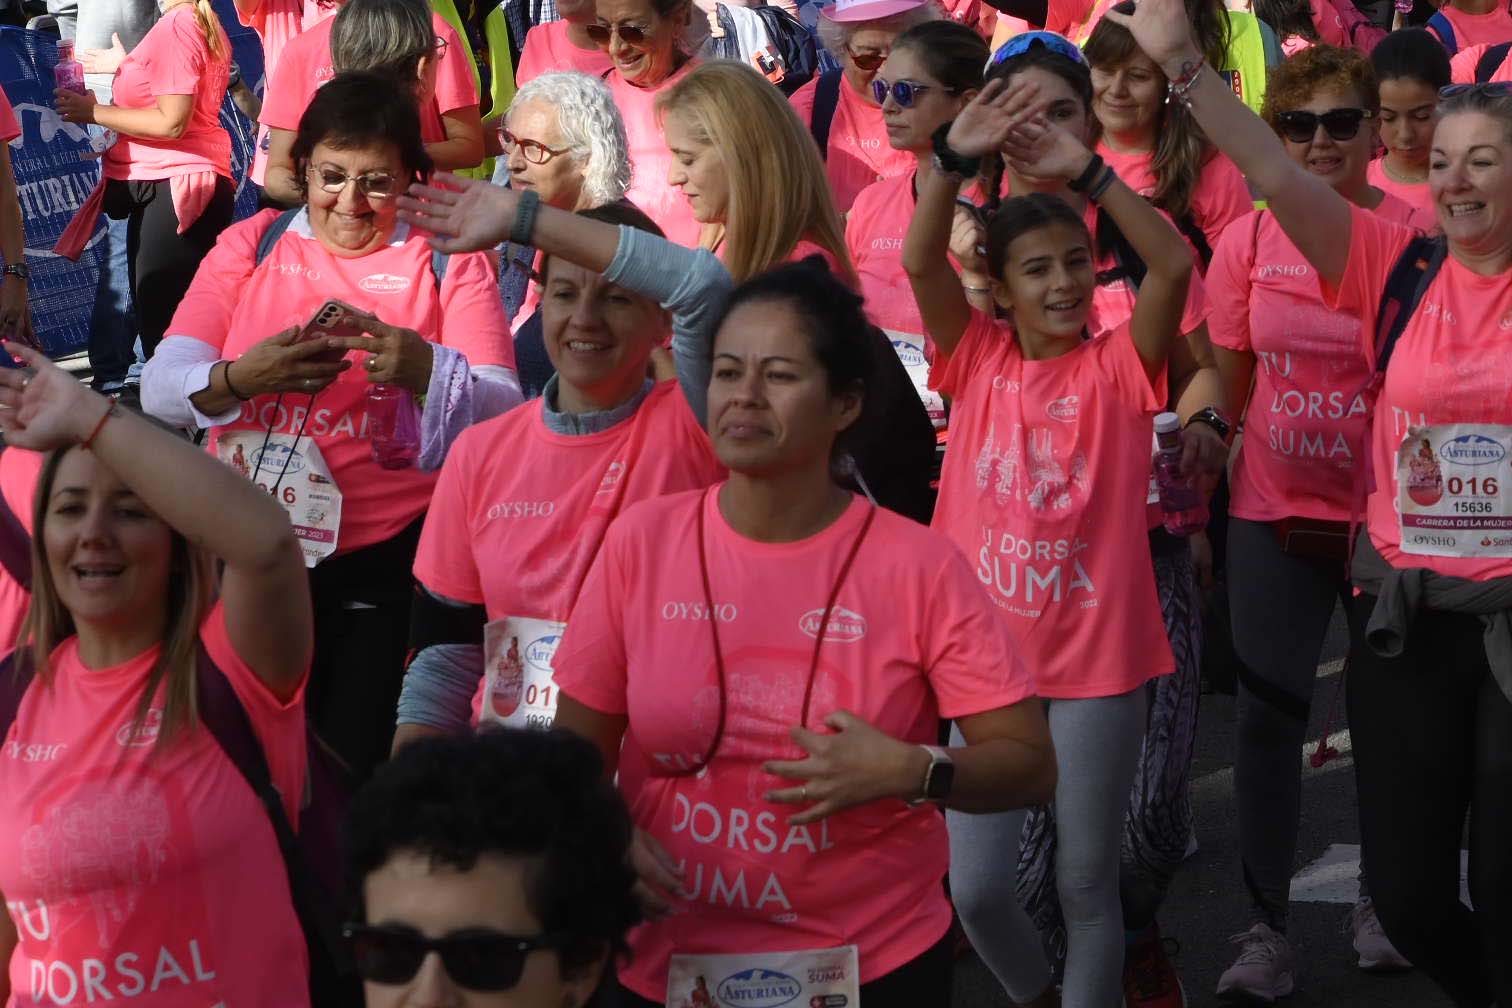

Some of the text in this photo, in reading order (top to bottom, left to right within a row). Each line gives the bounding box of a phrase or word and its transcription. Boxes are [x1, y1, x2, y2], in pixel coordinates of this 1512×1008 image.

[15, 158, 50, 174] NTRAL
[871, 238, 903, 250] OYSH
[1259, 265, 1308, 278] OYSHO
[1259, 351, 1292, 377] TU
[992, 376, 1021, 393] OYS
[1268, 425, 1352, 458] SUMA
[1445, 445, 1500, 458] ASTURIANA
[1447, 477, 1499, 495] 016
[487, 501, 555, 520] OYSHO
[1453, 502, 1493, 514] 15636
[1416, 518, 1454, 527] CARRERA
[1456, 519, 1468, 527] DE
[1414, 534, 1456, 547] OYSHO
[978, 546, 1096, 603] SUMA
[525, 684, 558, 707] 01
[526, 712, 554, 730] 1920
[672, 793, 834, 855] DORSAL
[675, 864, 793, 912] UMA
[29, 939, 216, 1005] DORSAL
[723, 985, 795, 1000] ASTURIANA
